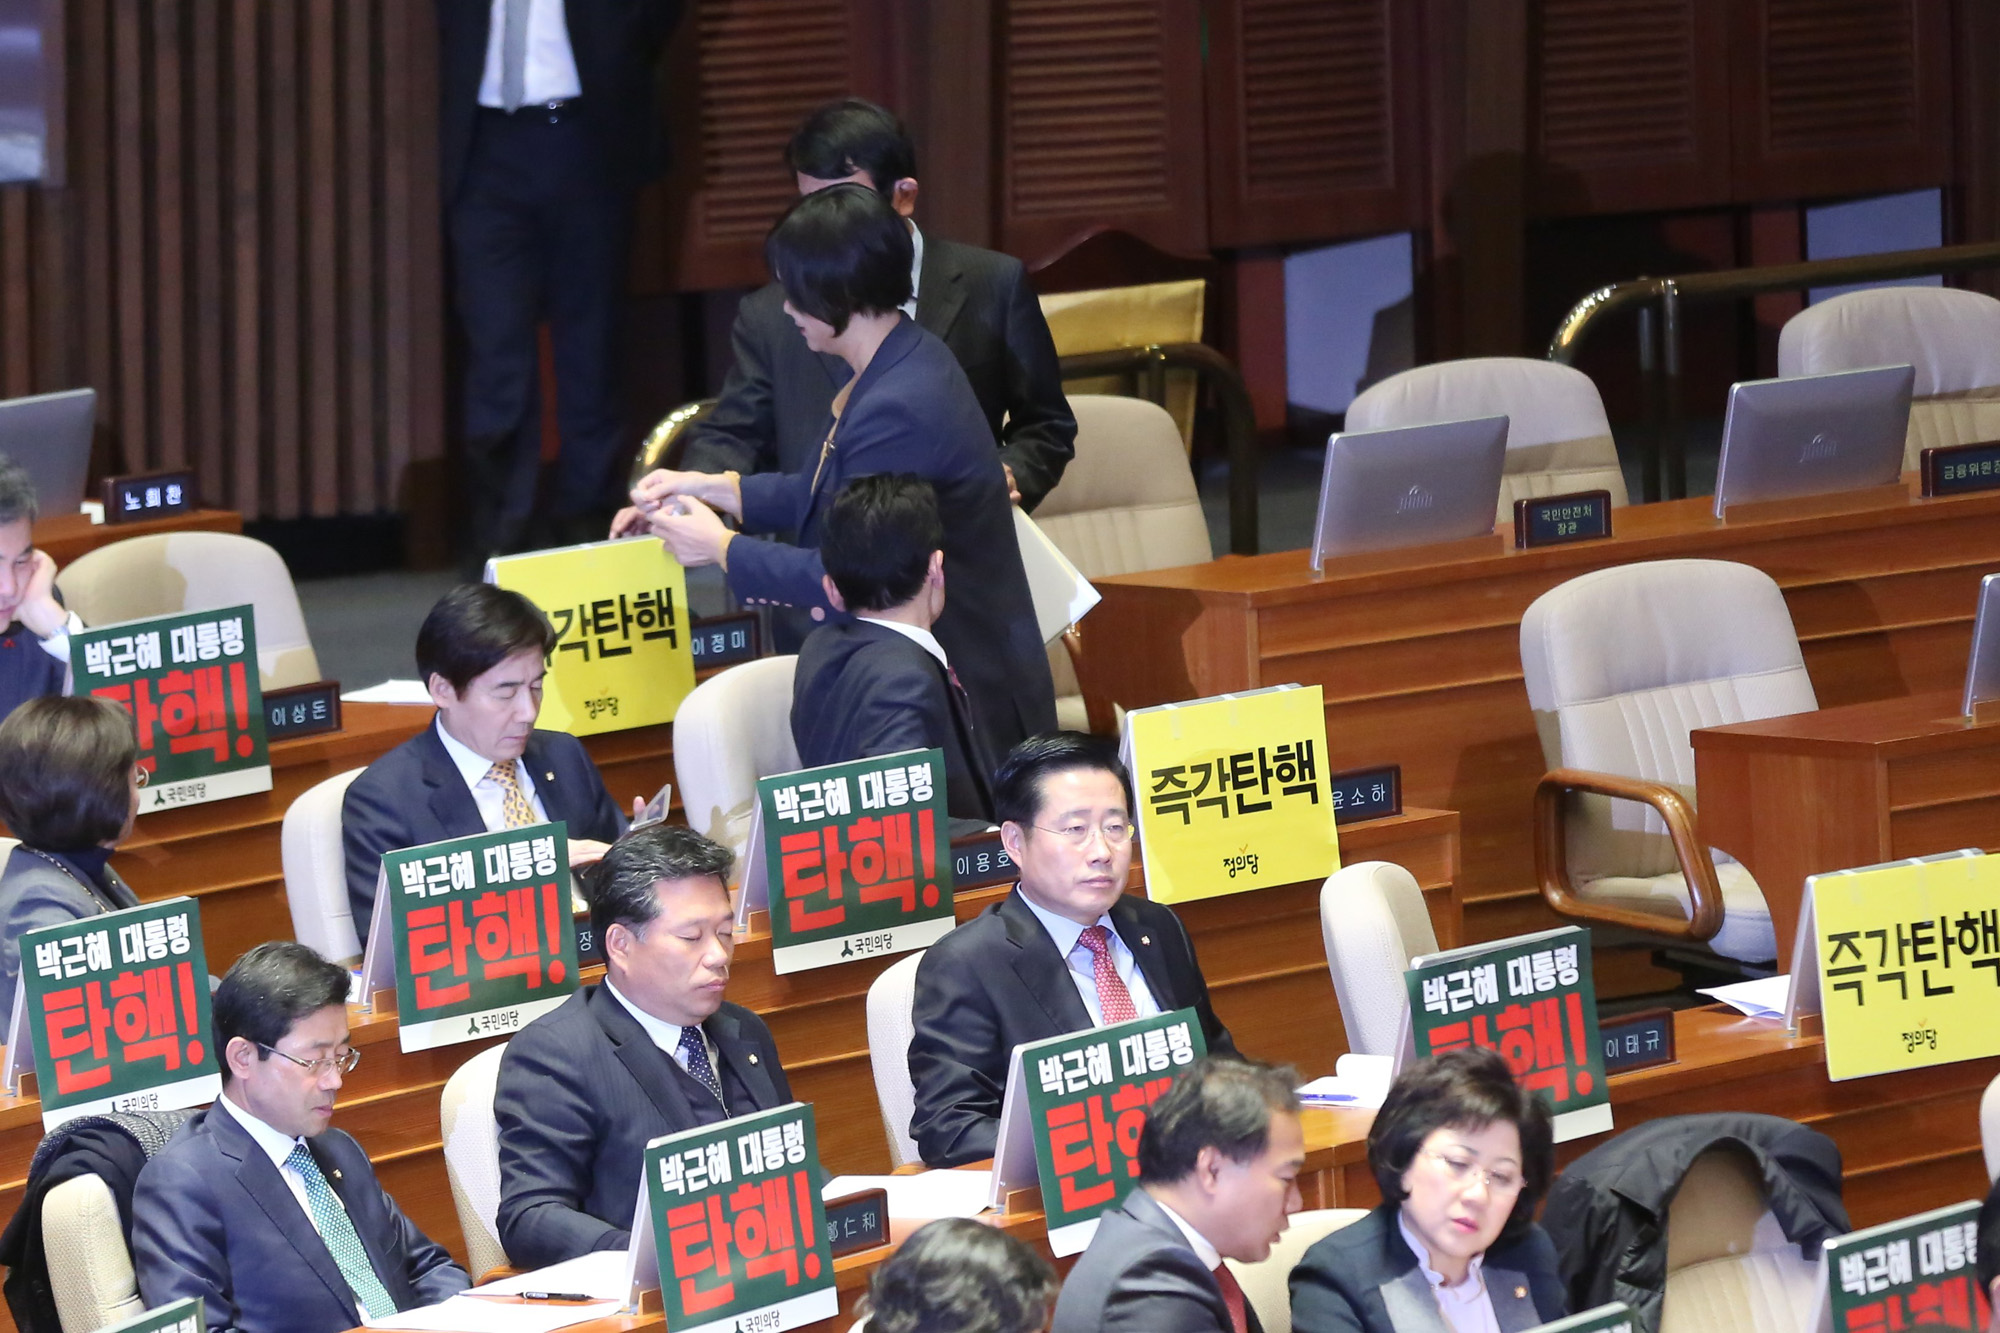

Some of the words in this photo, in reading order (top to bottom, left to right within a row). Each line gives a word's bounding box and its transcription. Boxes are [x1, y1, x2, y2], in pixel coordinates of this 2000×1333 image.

[1541, 504, 1592, 522] 국민안전처
[1557, 521, 1578, 536] 장관
[83, 631, 163, 678] 박근혜
[170, 617, 246, 664] 대통령
[545, 587, 678, 668] 각탄핵
[691, 629, 746, 656] 이정미
[271, 699, 327, 726] 이상돈
[584, 696, 619, 720] 정의당
[772, 776, 851, 824] 박근혜
[857, 762, 934, 810] 대통령
[1149, 738, 1320, 826] 즉각탄핵
[1331, 783, 1386, 810] 윤소하
[399, 850, 476, 900] 박근혜
[483, 835, 558, 885] 대통령
[780, 808, 940, 933] 탄핵!
[956, 849, 1011, 875] 이용호
[1222, 853, 1259, 879] 정의당
[35, 929, 113, 981] 박근혜
[118, 912, 191, 965] 대통령
[406, 883, 566, 1010] 탄핵!
[854, 933, 893, 954] 국민의당
[1826, 908, 2000, 1006] 즉각탄핵
[1421, 963, 1500, 1016] 박근혜
[1506, 944, 1580, 997] 대통령
[42, 961, 205, 1095] 탄핵!
[481, 1010, 519, 1031] 국민의당
[1606, 1030, 1660, 1058] 이태규
[1901, 1028, 1938, 1053] 정의당
[1037, 1042, 1114, 1096] 박근혜
[1118, 1021, 1195, 1077] 대통령
[659, 1139, 733, 1196] 박근혜
[737, 1119, 807, 1176] 대통령
[666, 1170, 821, 1316] 탄핵!
[1838, 1239, 1913, 1297] 박근혜
[745, 1310, 780, 1333] 국민의당
